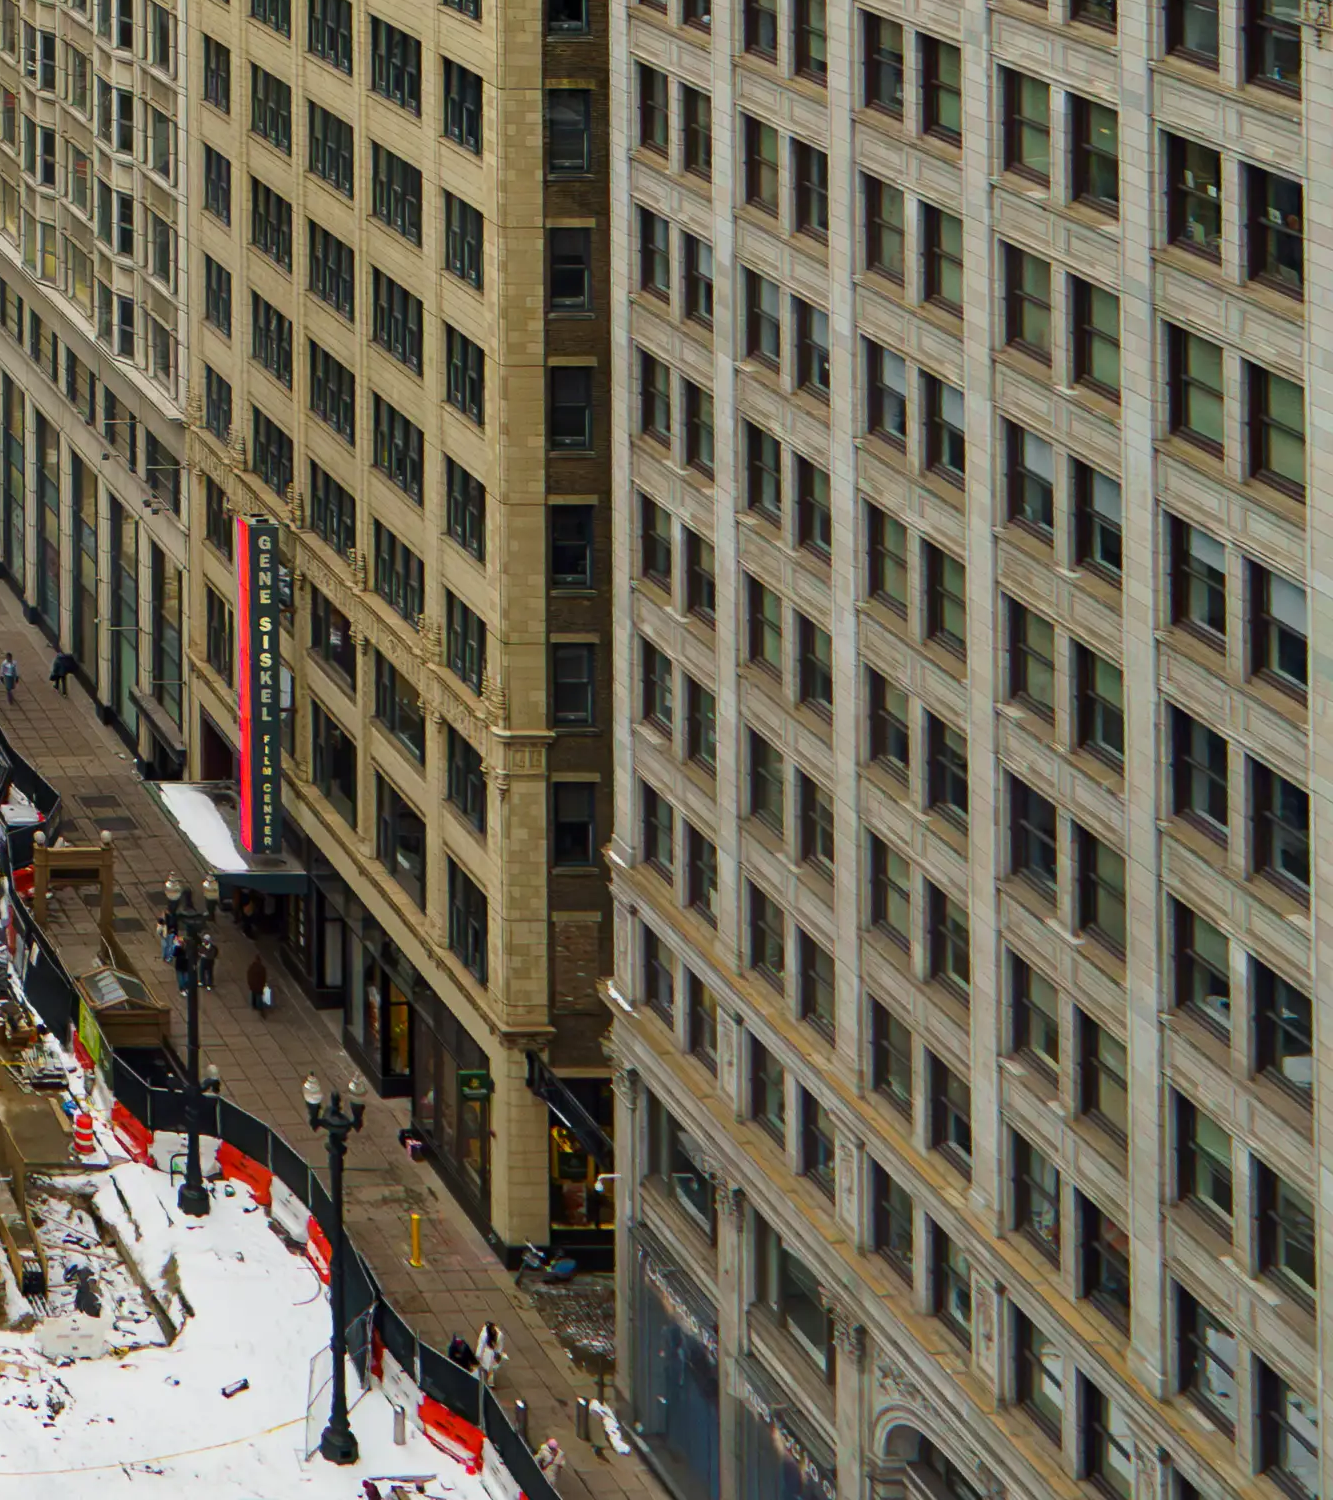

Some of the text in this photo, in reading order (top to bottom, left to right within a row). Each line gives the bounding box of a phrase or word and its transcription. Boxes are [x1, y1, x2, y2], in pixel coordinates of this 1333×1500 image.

[258, 535, 273, 847] GENE SISKEL FILM CENTER
